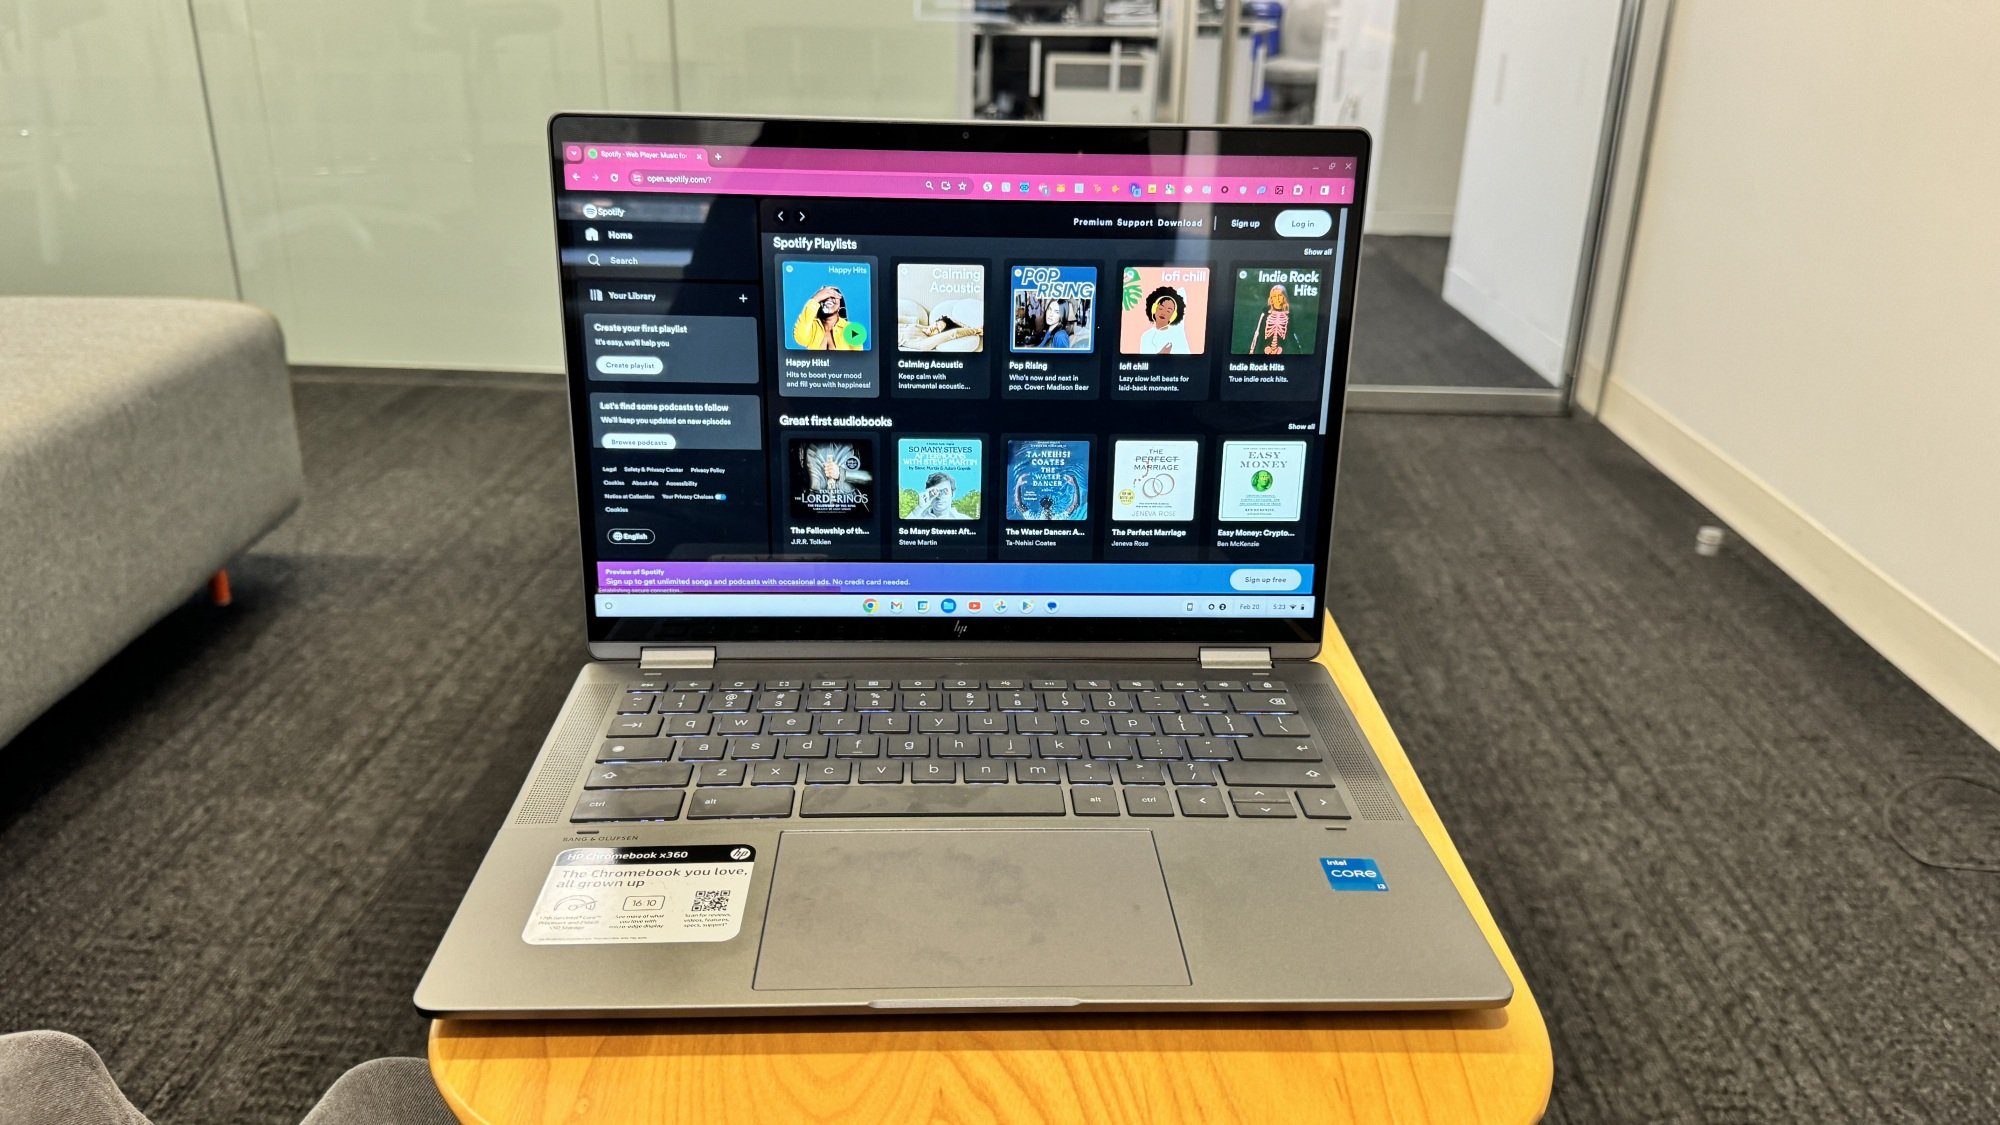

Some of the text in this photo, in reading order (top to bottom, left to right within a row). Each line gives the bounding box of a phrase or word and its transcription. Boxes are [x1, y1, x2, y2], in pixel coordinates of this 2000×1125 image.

[648, 175, 711, 185] open.spotify.com/?
[598, 208, 625, 217] Spotify
[1073, 218, 1202, 228] Premium Support Download
[1231, 220, 1260, 229] Sign up
[1292, 220, 1314, 229] Log in
[608, 231, 633, 240] Home
[774, 236, 857, 252] Spotify Playlists
[610, 257, 638, 265] Search
[829, 266, 867, 275] Happy Hits
[932, 268, 980, 282] Calming
[1021, 268, 1060, 286] POP
[1162, 271, 1206, 282] lofi chill
[1259, 271, 1319, 283] Indie Rock
[930, 282, 981, 294] Acoustic
[1037, 282, 1095, 299] RISING
[1294, 285, 1318, 296] Hits
[608, 291, 656, 302] Your Library
[594, 323, 621, 332] Create
[642, 324, 658, 332] first
[659, 325, 688, 334] playlist
[786, 358, 829, 368] Happy Hits!
[898, 360, 963, 370] Calming Acoustic
[1009, 362, 1048, 371] Pop Rising
[1120, 362, 1149, 371] lofi chill
[1229, 363, 1248, 371] Indie
[600, 402, 619, 410] Let's
[620, 402, 636, 411] find
[659, 404, 694, 412] podcasts
[704, 404, 728, 412] follow
[780, 415, 892, 427] Great first audiobooks
[802, 493, 868, 503] LORD RINGS
[806, 527, 845, 535] Fellowship
[910, 528, 930, 536] Many
[1154, 529, 1186, 537] Marriage
[1218, 529, 1236, 537] Easy
[1236, 529, 1262, 537] Money:
[623, 533, 647, 541] English
[606, 578, 623, 586] Sign
[1245, 576, 1260, 584] Sign
[686, 719, 696, 729] q
[734, 718, 749, 726] w
[786, 718, 796, 726] e
[699, 743, 709, 751] a
[802, 741, 813, 749] d
[904, 741, 914, 750] g
[717, 768, 727, 776] z
[586, 852, 657, 860] Chromebook
[730, 848, 750, 860] hp
[563, 867, 748, 879] The Chromebook you love,
[556, 880, 573, 888] all
[578, 880, 623, 889] grown
